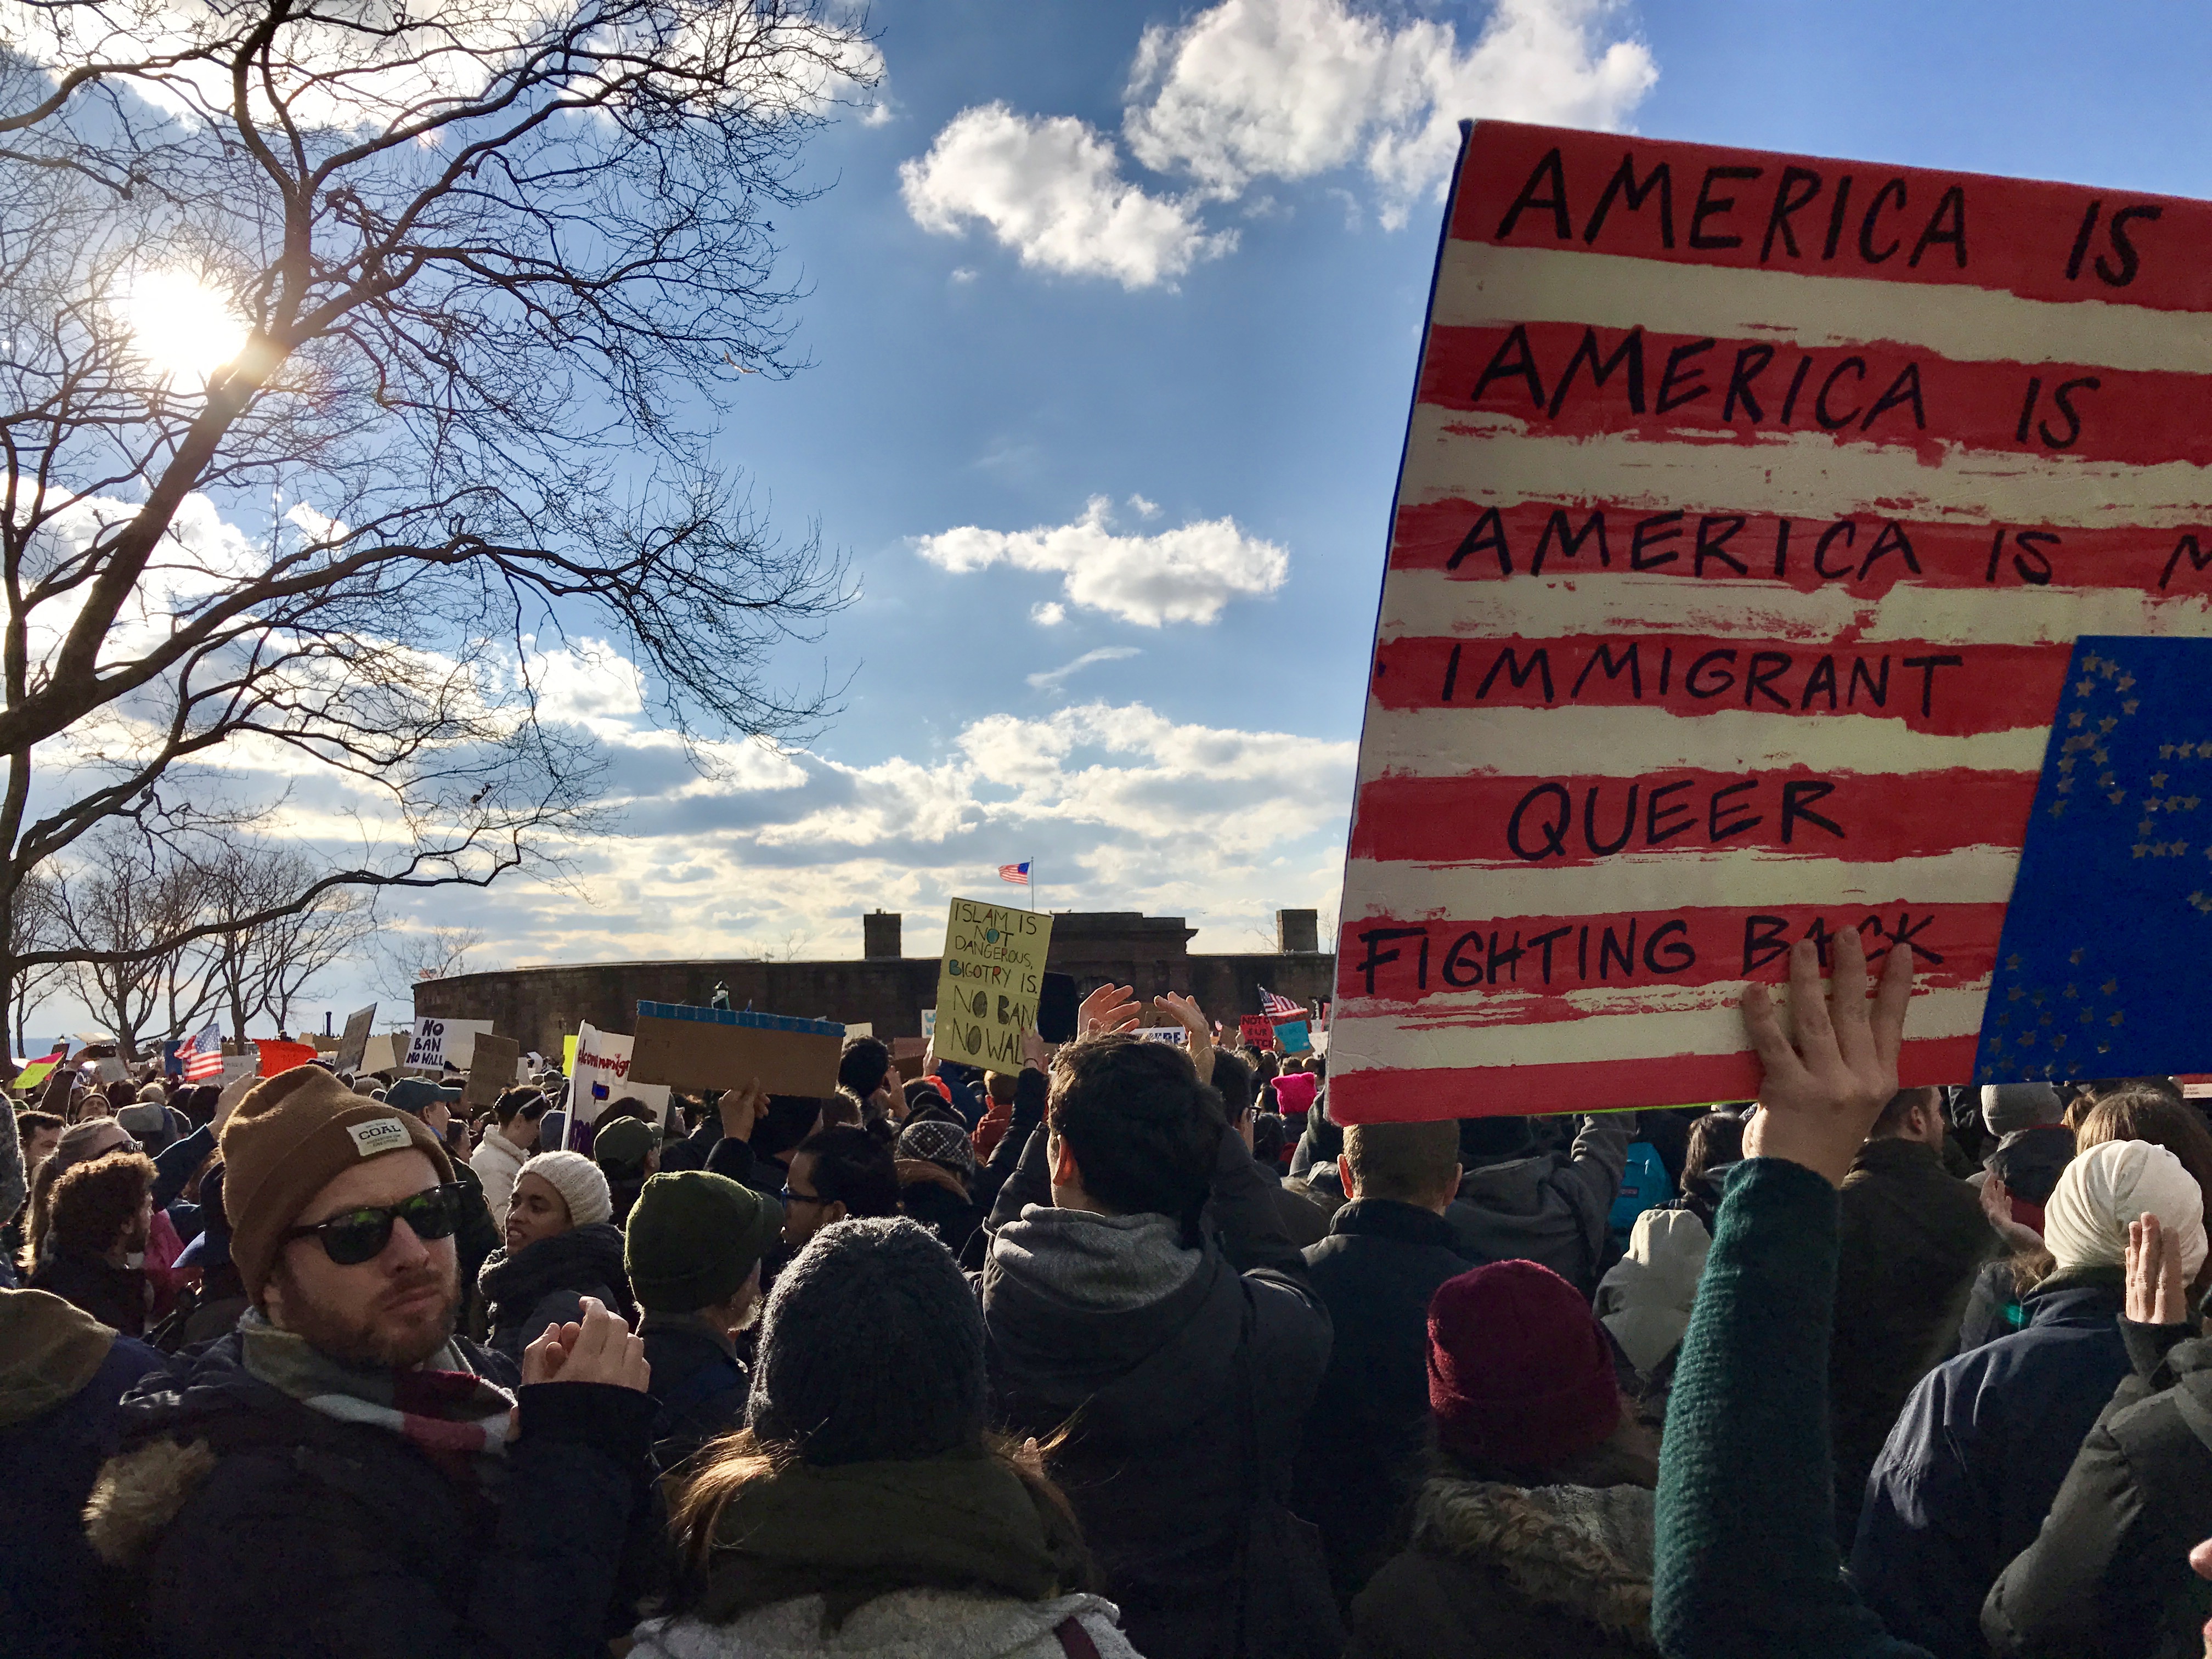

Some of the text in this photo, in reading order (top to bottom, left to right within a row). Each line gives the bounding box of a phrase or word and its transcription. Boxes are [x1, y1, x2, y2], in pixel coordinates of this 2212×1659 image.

[1495, 148, 2163, 287] AMERICA IS
[1471, 324, 2101, 449] AMERICA IS
[1446, 506, 1922, 581] AMERICA
[1985, 529, 2062, 585] IS
[1442, 642, 1963, 718] IMMIGRANT
[1507, 780, 1845, 861] QUEER
[955, 903, 1037, 935] ISLAM IS
[974, 925, 1014, 947] NOT
[955, 935, 1033, 970] DANGEROUS,
[1356, 917, 1696, 995] FIGHTING
[949, 959, 1012, 988] BIGOTRY
[953, 985, 1036, 1030] NO BAN
[1242, 1016, 1261, 1025] NOT
[414, 1037, 442, 1052] BAN
[421, 1019, 444, 1037] NO
[951, 1017, 982, 1055] NO
[986, 1028, 1023, 1065] WAL
[406, 1052, 443, 1066] NO WALL
[358, 1125, 402, 1140] COAL
